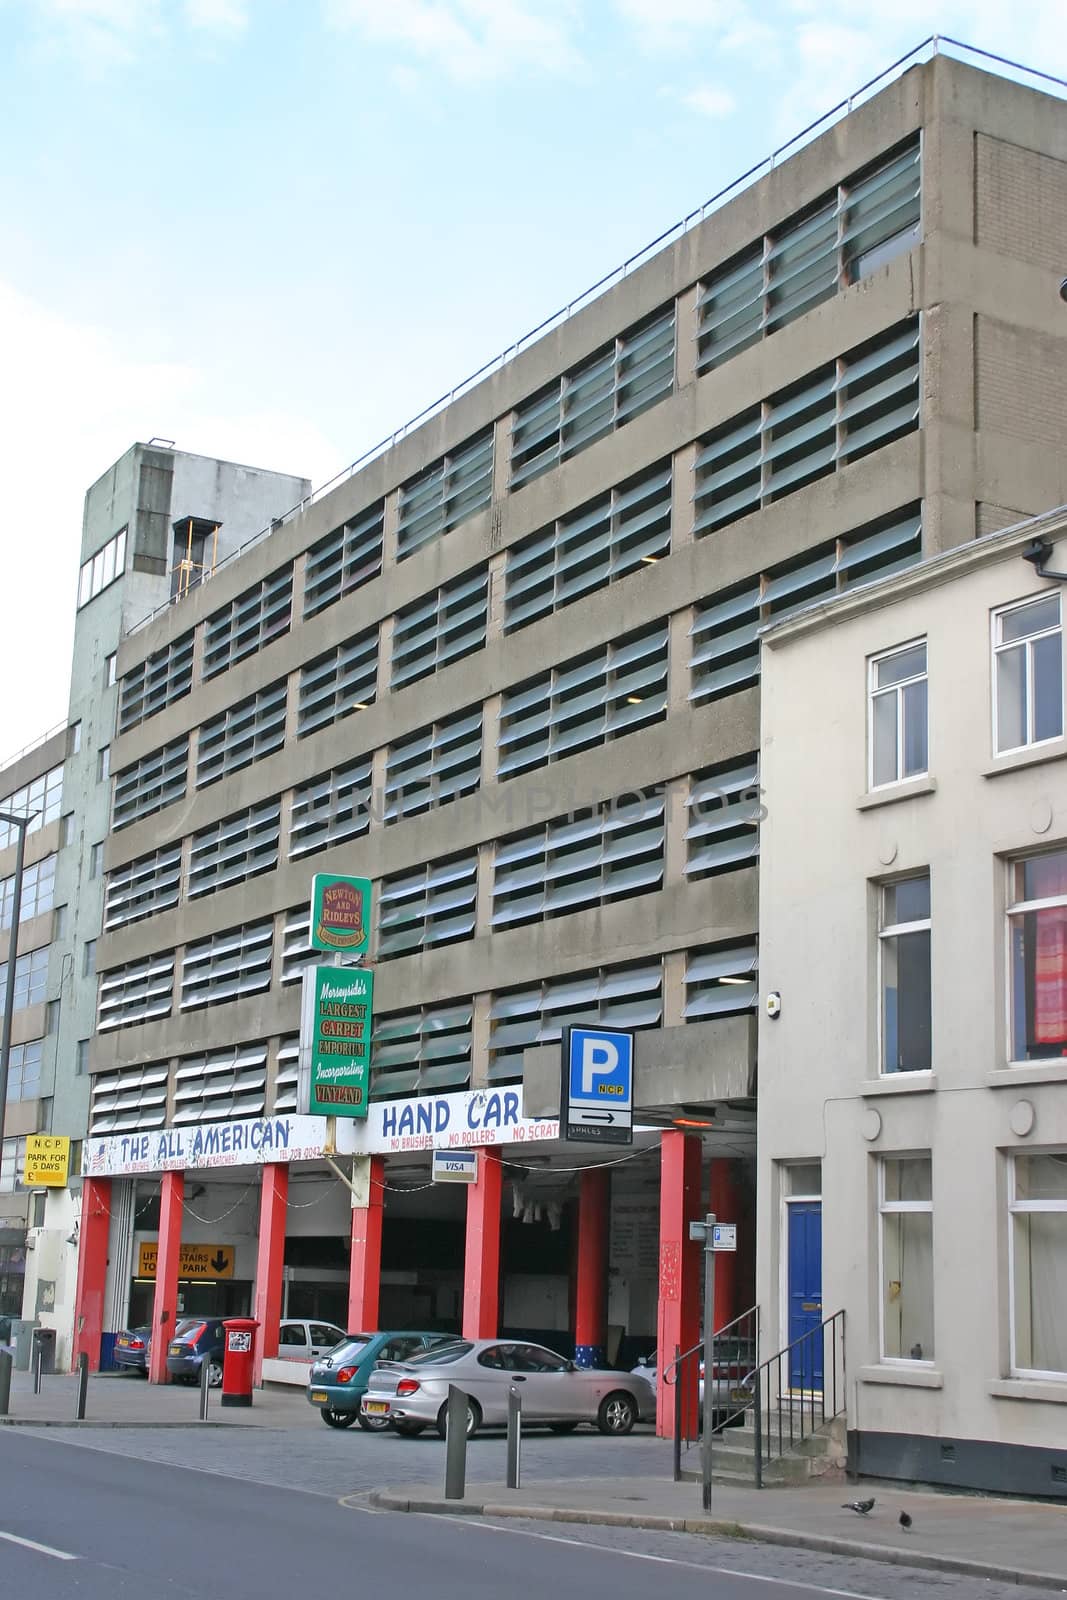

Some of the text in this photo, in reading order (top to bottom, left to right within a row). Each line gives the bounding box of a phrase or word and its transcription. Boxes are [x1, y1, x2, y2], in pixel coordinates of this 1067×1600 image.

[325, 888, 361, 907] NEWTON
[336, 901, 350, 910] AND
[323, 908, 360, 925] RIDLEYS
[320, 978, 367, 1002] Merseyside's
[320, 1001, 367, 1018] LARGEST
[321, 1021, 364, 1037] CARPET
[319, 1040, 365, 1056] EMPORIUM
[316, 1059, 364, 1083] Incorporating
[582, 1038, 619, 1093] P
[316, 1085, 362, 1104] VINYLAND
[599, 1084, 624, 1095] NCP
[383, 1092, 519, 1137] HAND CAR
[121, 1119, 290, 1162] THE ALL AMERICAN
[391, 1122, 560, 1149] NO BRUSHES NO ROLLERS NO SCRAT
[32, 1162, 38, 1170] 5
[50, 1154, 66, 1162] FOR
[445, 1162, 465, 1171] VISA
[143, 1263, 207, 1272] TO PARK
